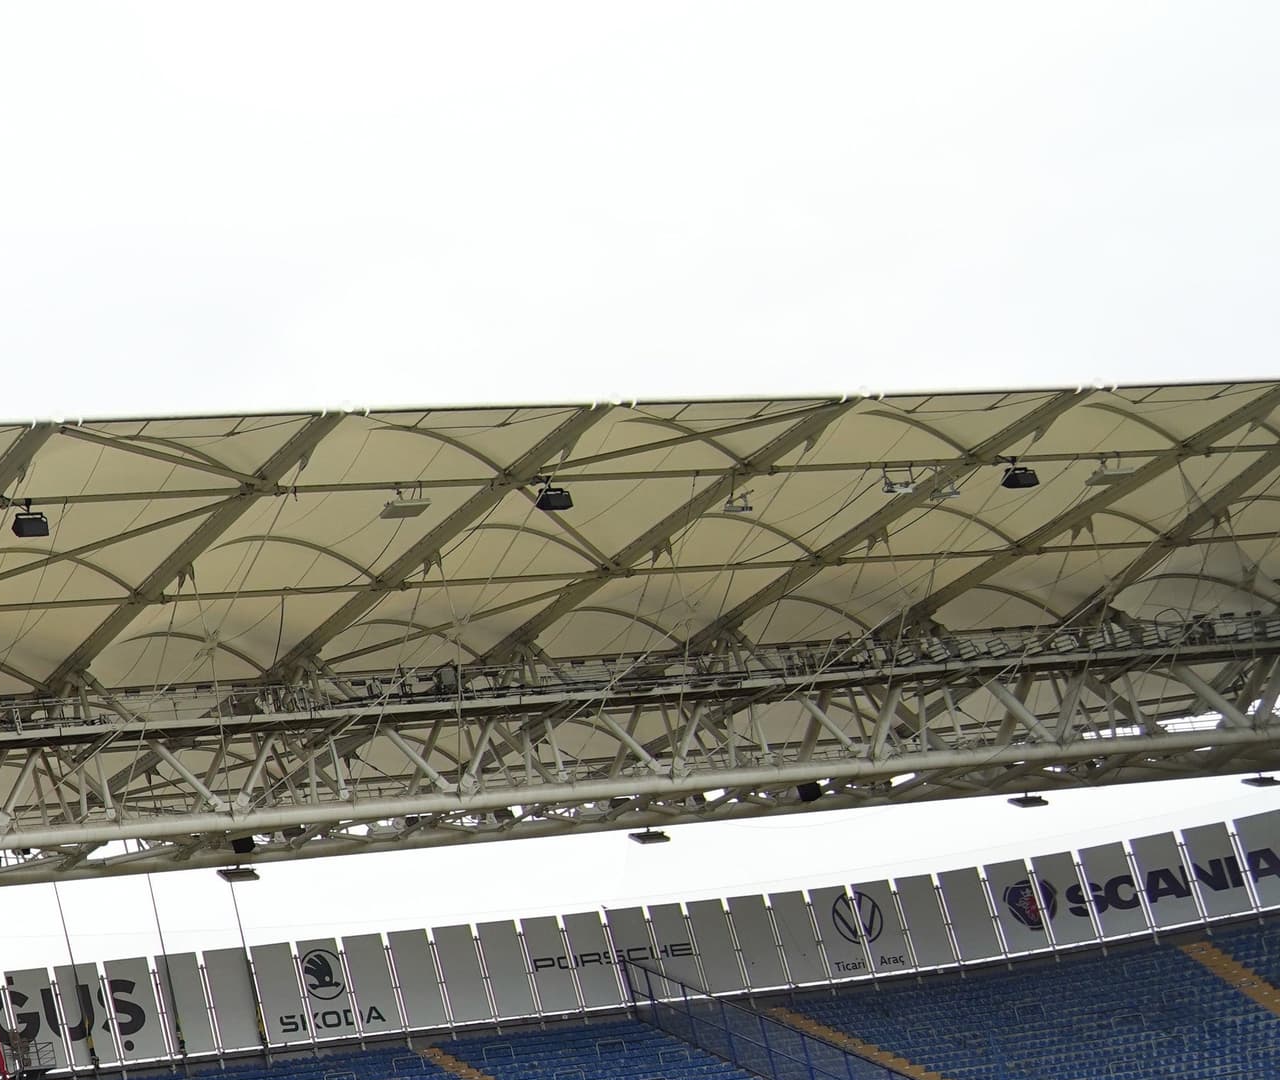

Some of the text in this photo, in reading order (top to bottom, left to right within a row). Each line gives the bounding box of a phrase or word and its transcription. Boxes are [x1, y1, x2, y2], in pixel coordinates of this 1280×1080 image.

[1066, 848, 1280, 917] SCANIA
[533, 942, 694, 972] PORSCHE
[835, 952, 905, 973] Ticari Araç
